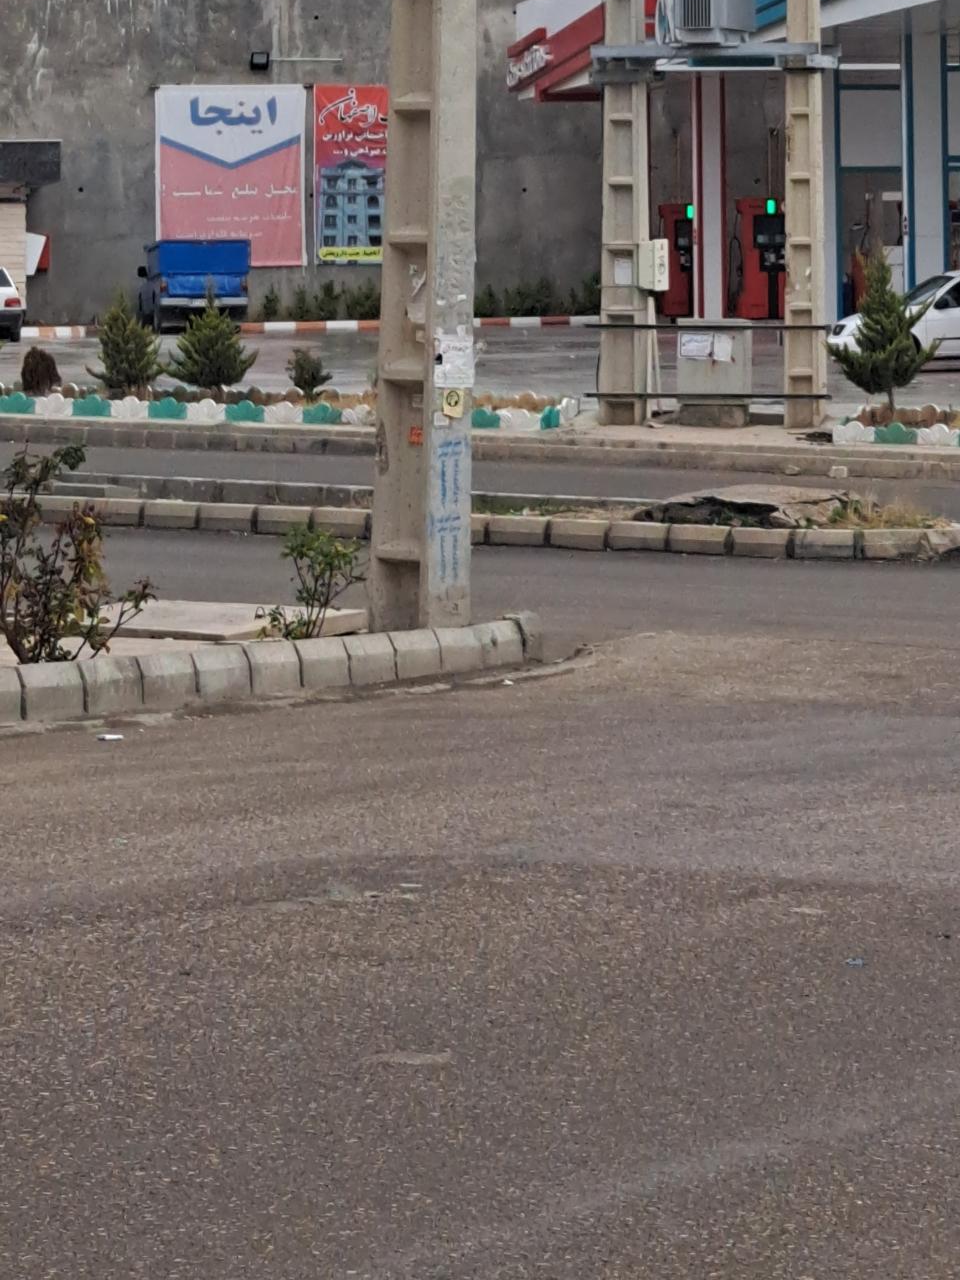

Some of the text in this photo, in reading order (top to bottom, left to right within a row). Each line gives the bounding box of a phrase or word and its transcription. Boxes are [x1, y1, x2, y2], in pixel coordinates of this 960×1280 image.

[188, 95, 278, 136] اینجا
[172, 183, 224, 197] شماست
[231, 182, 258, 200] تبلیغ
[264, 183, 297, 199] محل
